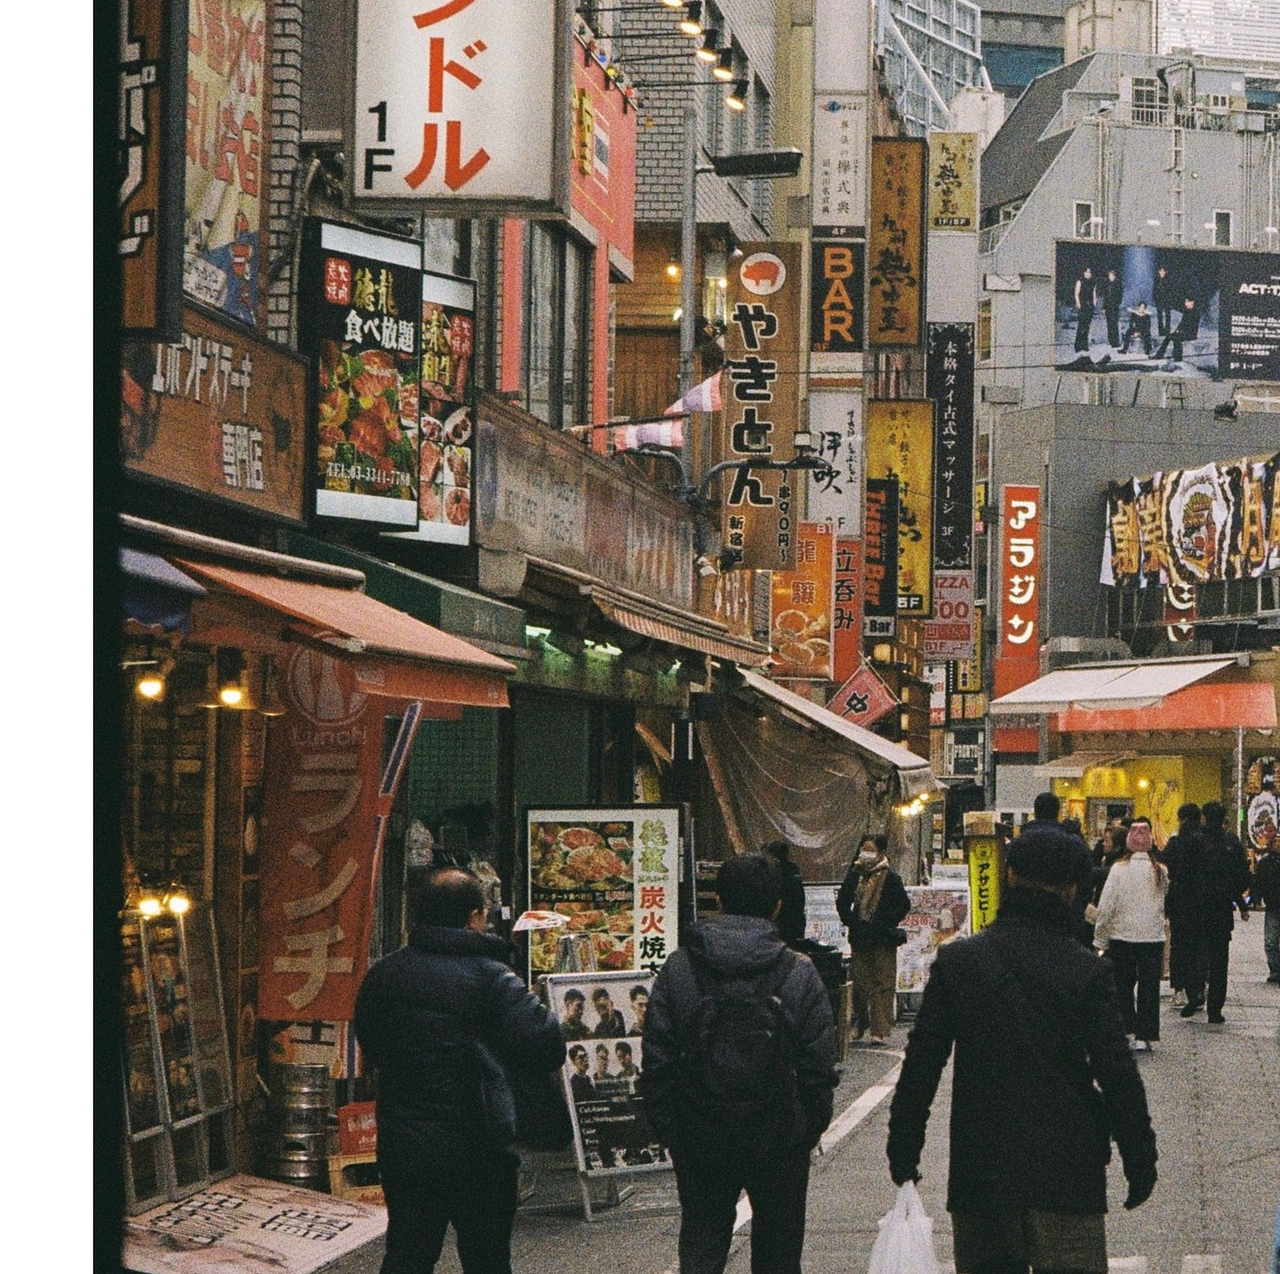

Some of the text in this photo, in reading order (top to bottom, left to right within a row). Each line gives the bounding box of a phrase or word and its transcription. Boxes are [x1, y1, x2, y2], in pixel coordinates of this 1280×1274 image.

[364, 100, 395, 191] 1F
[344, 308, 415, 354] 食べ放題
[821, 247, 855, 343] BAR
[728, 302, 778, 507] やきとん
[942, 339, 958, 515] 本格タイ古式マッサージ
[834, 548, 857, 630] 立呑み
[934, 576, 969, 589] IZZA
[1006, 499, 1036, 644] アラジン
[272, 752, 364, 1011] ランチ
